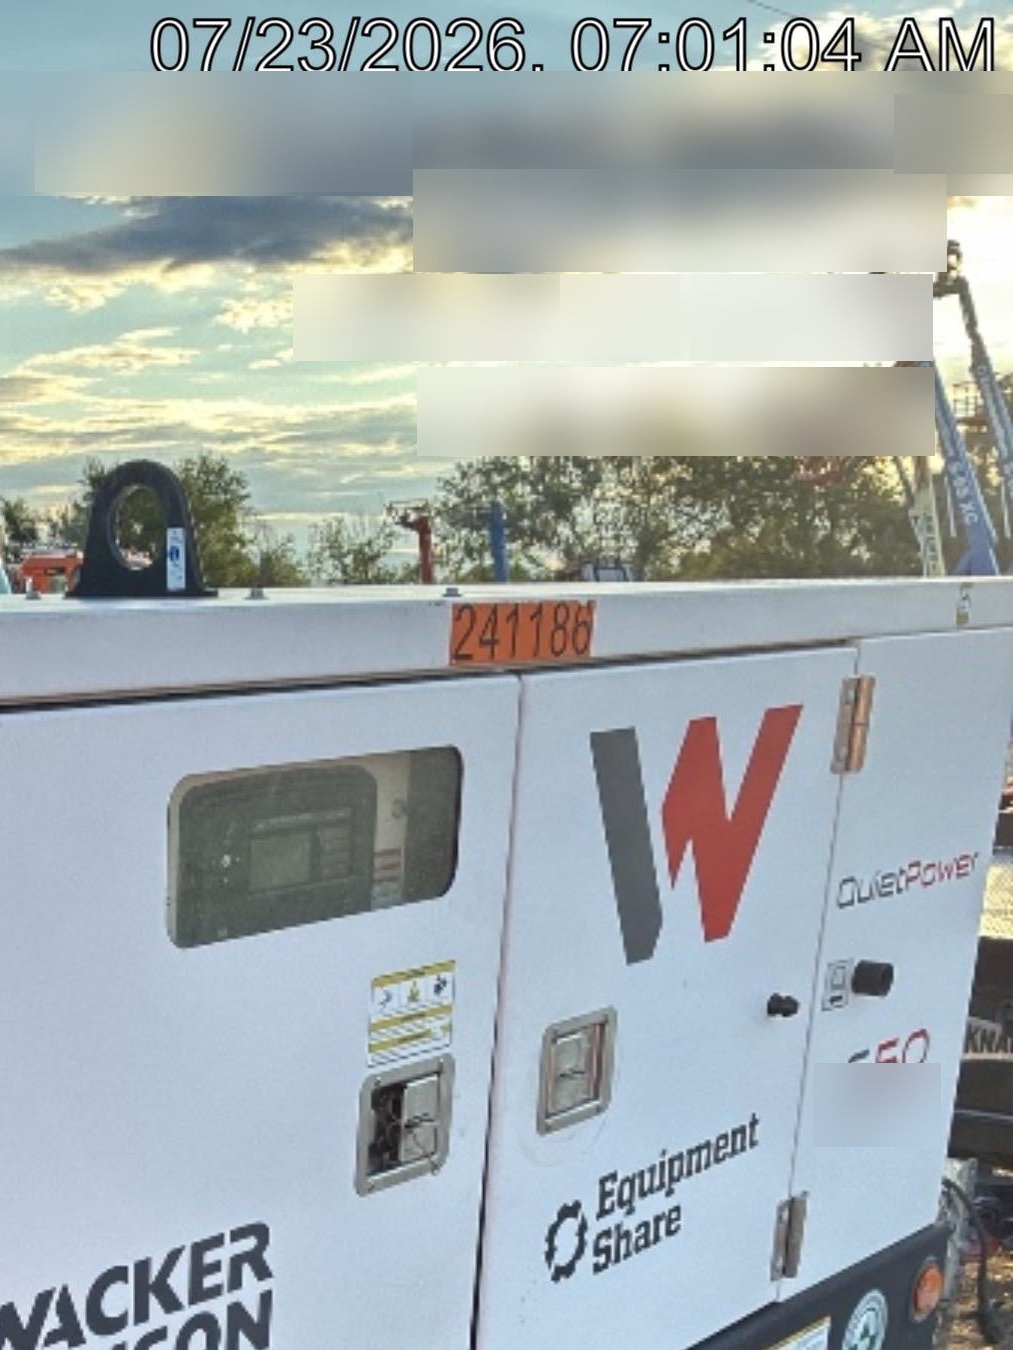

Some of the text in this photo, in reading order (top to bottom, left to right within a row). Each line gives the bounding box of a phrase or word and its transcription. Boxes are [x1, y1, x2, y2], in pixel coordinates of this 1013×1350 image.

[453, 600, 595, 660] 241186
[837, 852, 979, 909] QuietPower
[964, 1020, 1013, 1057] KNA
[596, 1111, 760, 1220] Equipment
[592, 1204, 682, 1275] Share
